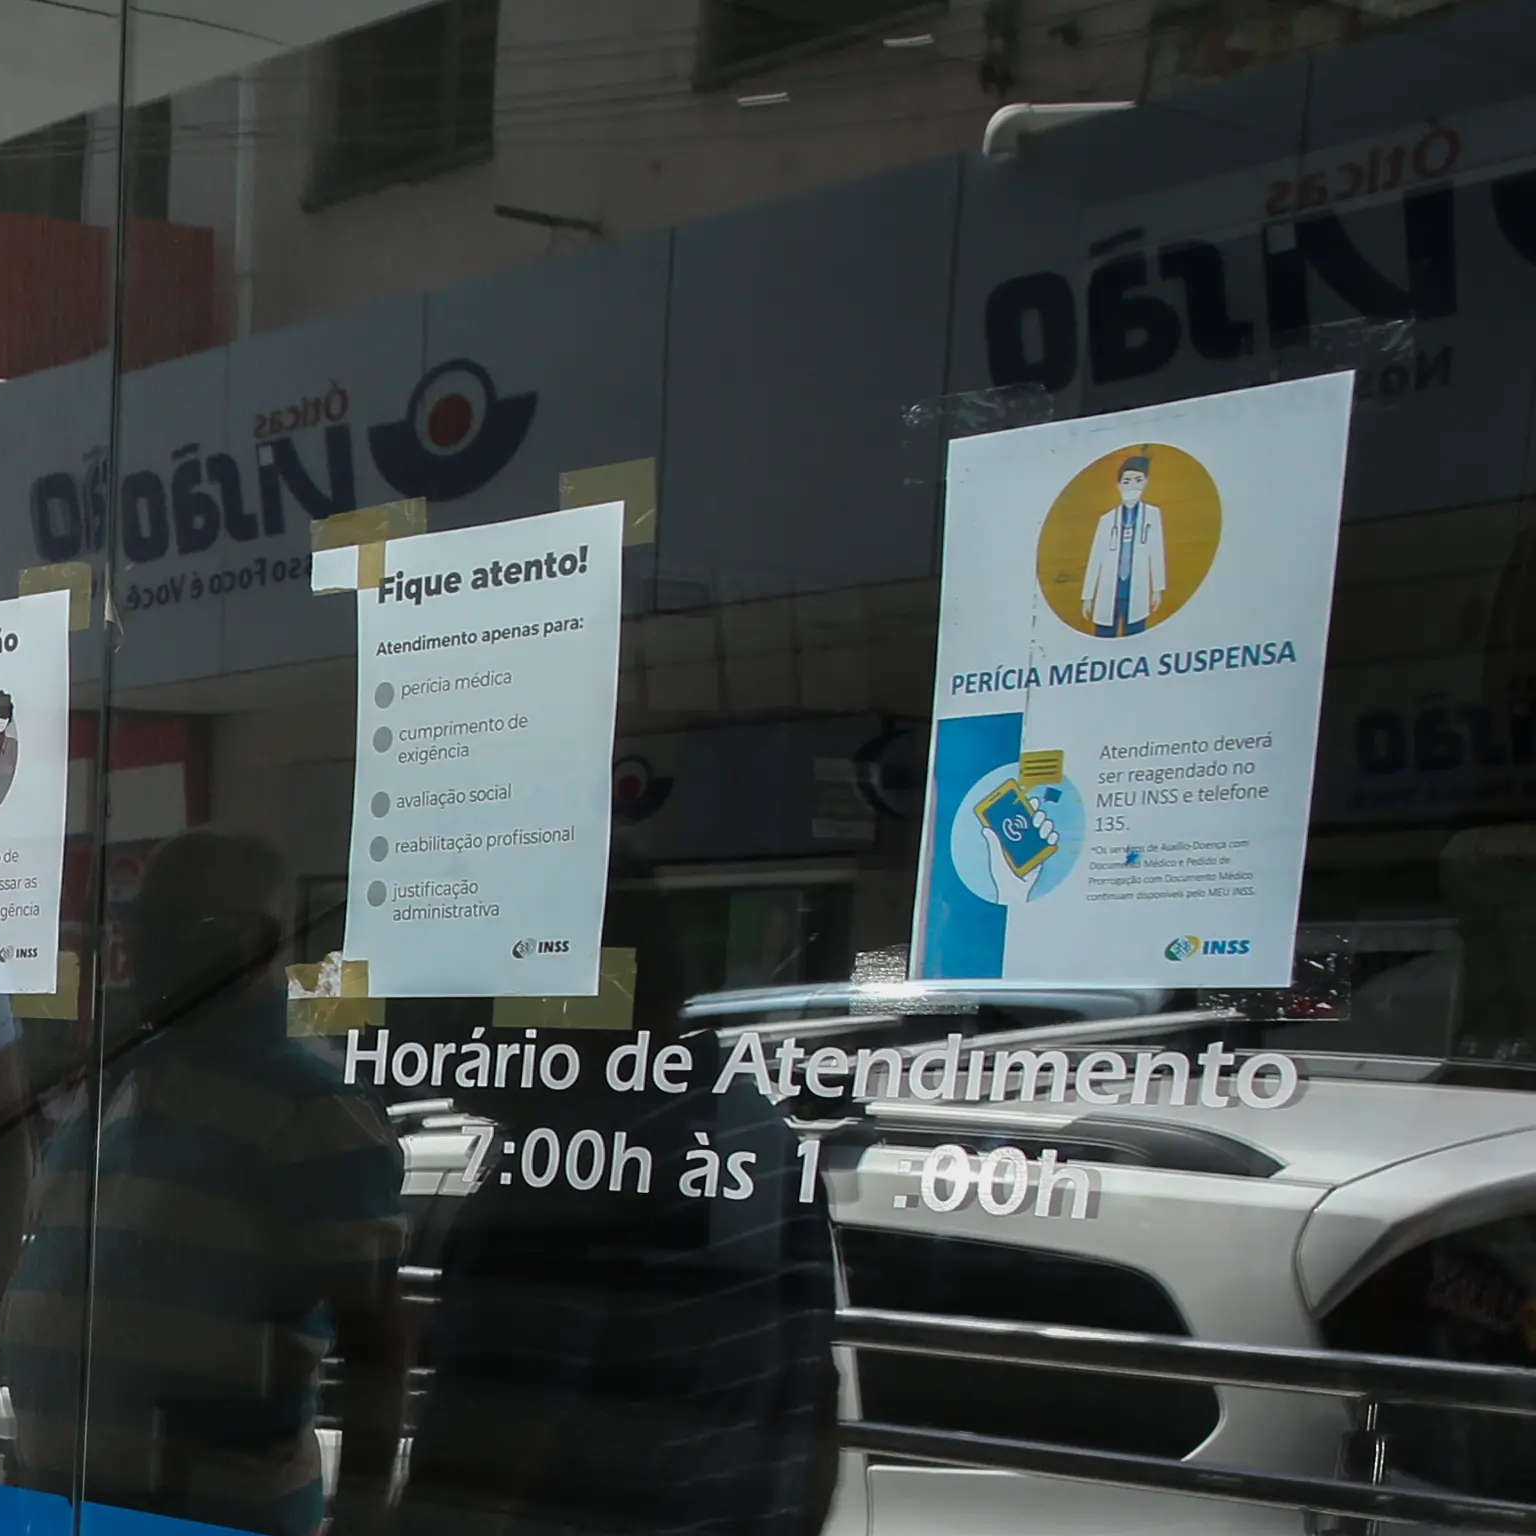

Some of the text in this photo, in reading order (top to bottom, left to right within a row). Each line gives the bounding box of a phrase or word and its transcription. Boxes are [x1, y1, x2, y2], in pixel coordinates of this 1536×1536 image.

[377, 545, 589, 606] Fique atento!
[375, 617, 584, 657] Atendimento apenas para:
[951, 640, 1297, 695] PERÍCIA MÉDICA SUSPENSA
[400, 670, 513, 700] perícia médica
[398, 713, 528, 741] cumprimento de
[398, 742, 470, 765] exigência
[1098, 731, 1273, 760] Atendimento deverá
[1097, 760, 1256, 785] ser reagendado no
[396, 783, 513, 810] avaliação social
[1096, 783, 1269, 808] MEU INSS e telefone
[1094, 815, 1130, 832] 135.
[395, 825, 575, 853] reabilitação profissional
[3, 849, 19, 863] de
[24, 876, 37, 890] as
[392, 880, 479, 902] justificação
[392, 901, 500, 921] administrativa
[15, 947, 38, 959] INSS
[537, 940, 569, 954] INSS
[1202, 939, 1250, 956] INSS
[342, 1025, 1301, 1111] Horário de Atendimento
[676, 1132, 755, 1200] às
